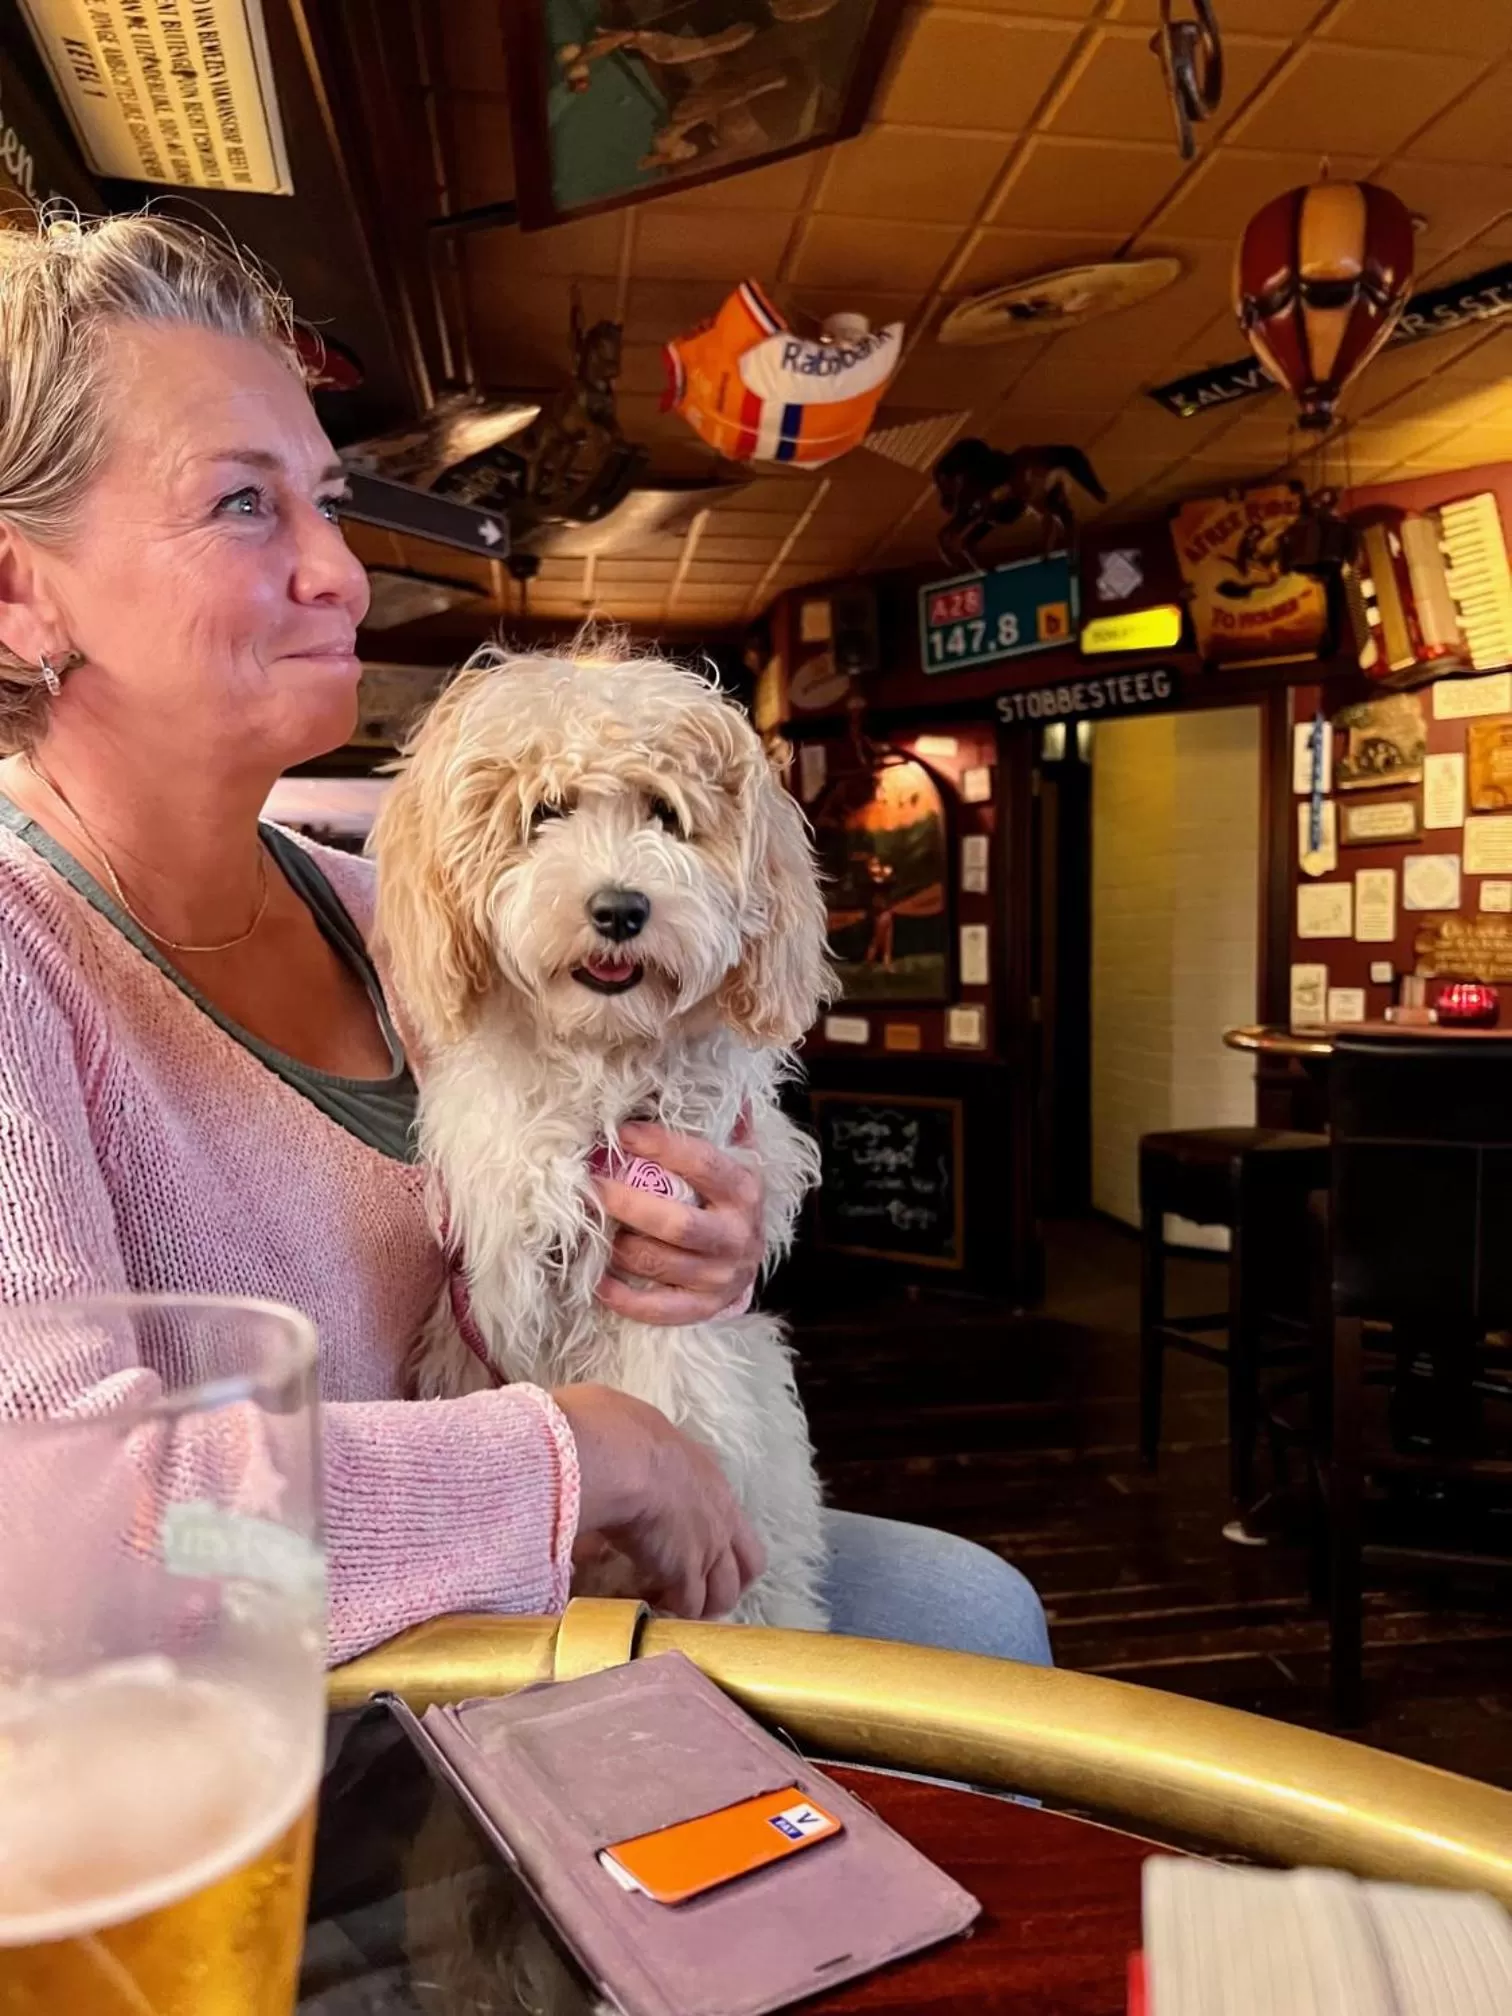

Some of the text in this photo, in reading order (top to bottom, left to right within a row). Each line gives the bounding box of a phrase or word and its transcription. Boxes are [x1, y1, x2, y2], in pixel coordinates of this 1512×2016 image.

[62, 38, 101, 82] KETEL
[161, 20, 201, 99] BUITENGEOON
[930, 612, 1019, 661] 147.8
[996, 669, 1172, 723] STOBBESTEEG
